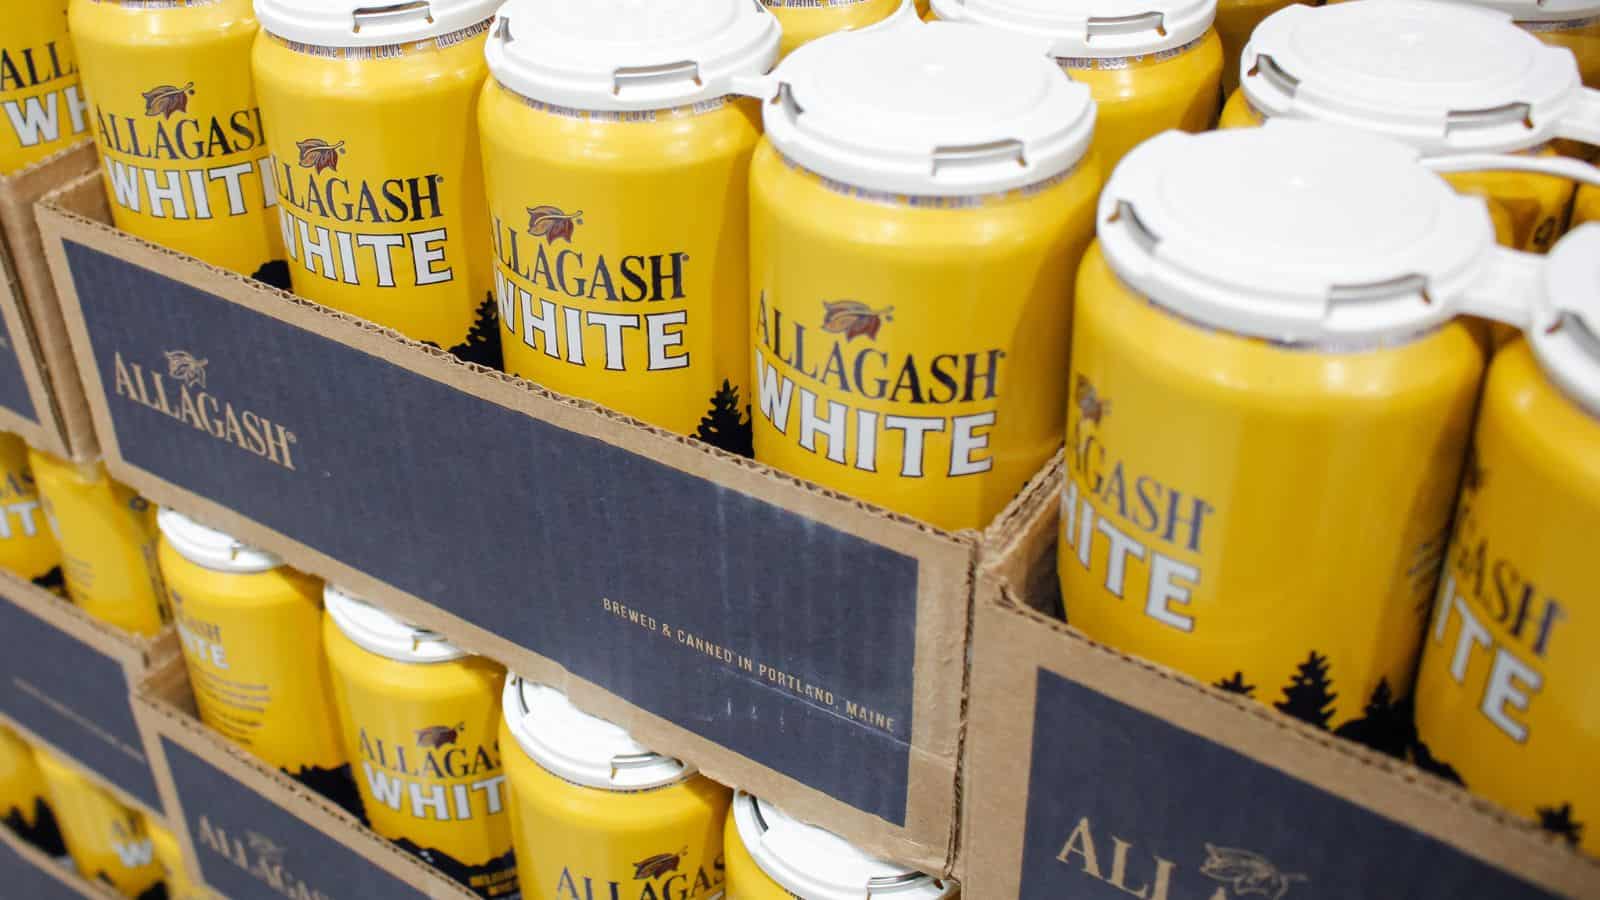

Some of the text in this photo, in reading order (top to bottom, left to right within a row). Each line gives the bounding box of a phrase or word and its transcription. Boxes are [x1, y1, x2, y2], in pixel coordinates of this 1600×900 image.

[0, 40, 80, 91] ALL
[494, 212, 686, 302] LLAGASH
[757, 288, 999, 404] ALLAGASH
[115, 351, 296, 471] ALLAGASH
[756, 345, 997, 477] WHITE
[602, 597, 656, 631] BREWED
[661, 622, 672, 638] &
[677, 629, 732, 664] CANNED
[738, 655, 753, 672] IN
[846, 700, 896, 732] MAINE
